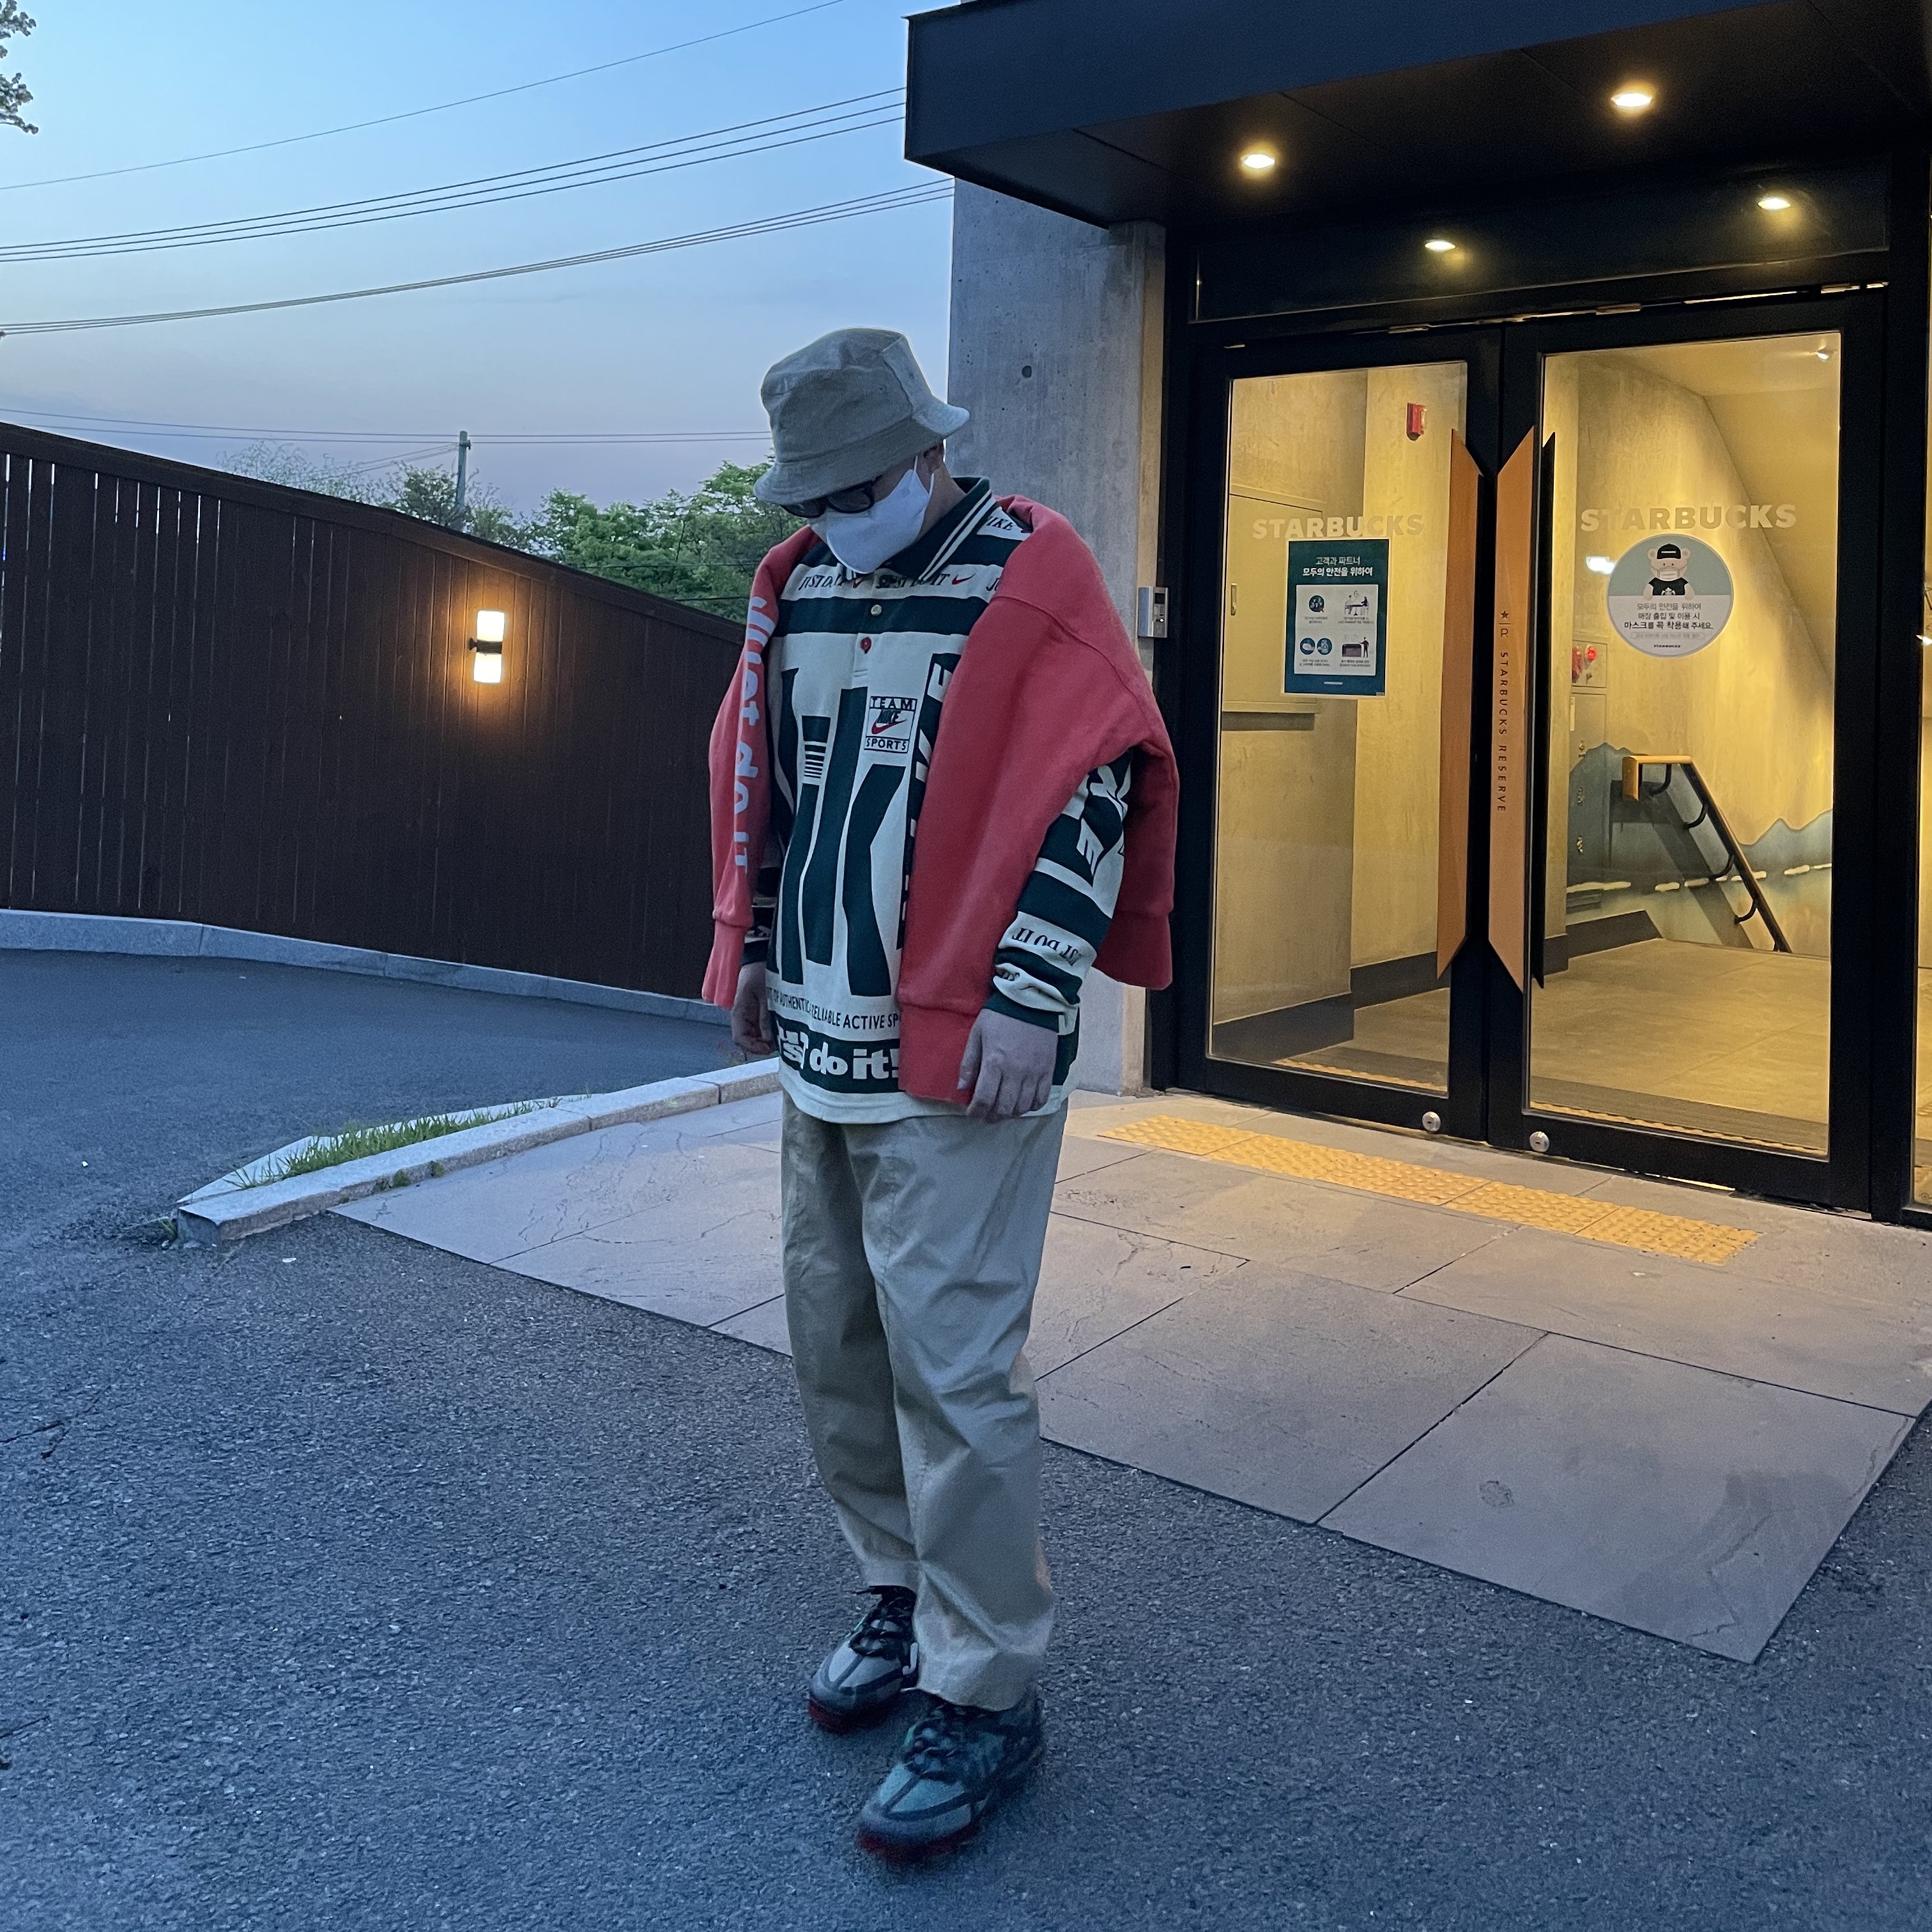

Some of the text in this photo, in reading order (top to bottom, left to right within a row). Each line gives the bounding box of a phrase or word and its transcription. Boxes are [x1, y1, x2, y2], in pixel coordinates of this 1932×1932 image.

[1252, 514, 1423, 539] STARBUCKS
[1581, 504, 1797, 532] STARBUCKS
[1315, 556, 1360, 565] 고객과 파트너
[1303, 567, 1373, 576] 모두의 안전을 위하여
[1624, 621, 1654, 629] 마스크를
[1667, 621, 1689, 630] 착용해
[1677, 612, 1690, 620] 이용
[1499, 652, 1508, 735] STARBUCKS
[872, 698, 914, 710] TEAM
[866, 738, 907, 751] SPORTS
[1498, 745, 1507, 811] RESERVE
[809, 1004, 841, 1027] RELIABLE
[843, 1014, 885, 1030] ACTIVE
[809, 1041, 848, 1076] do
